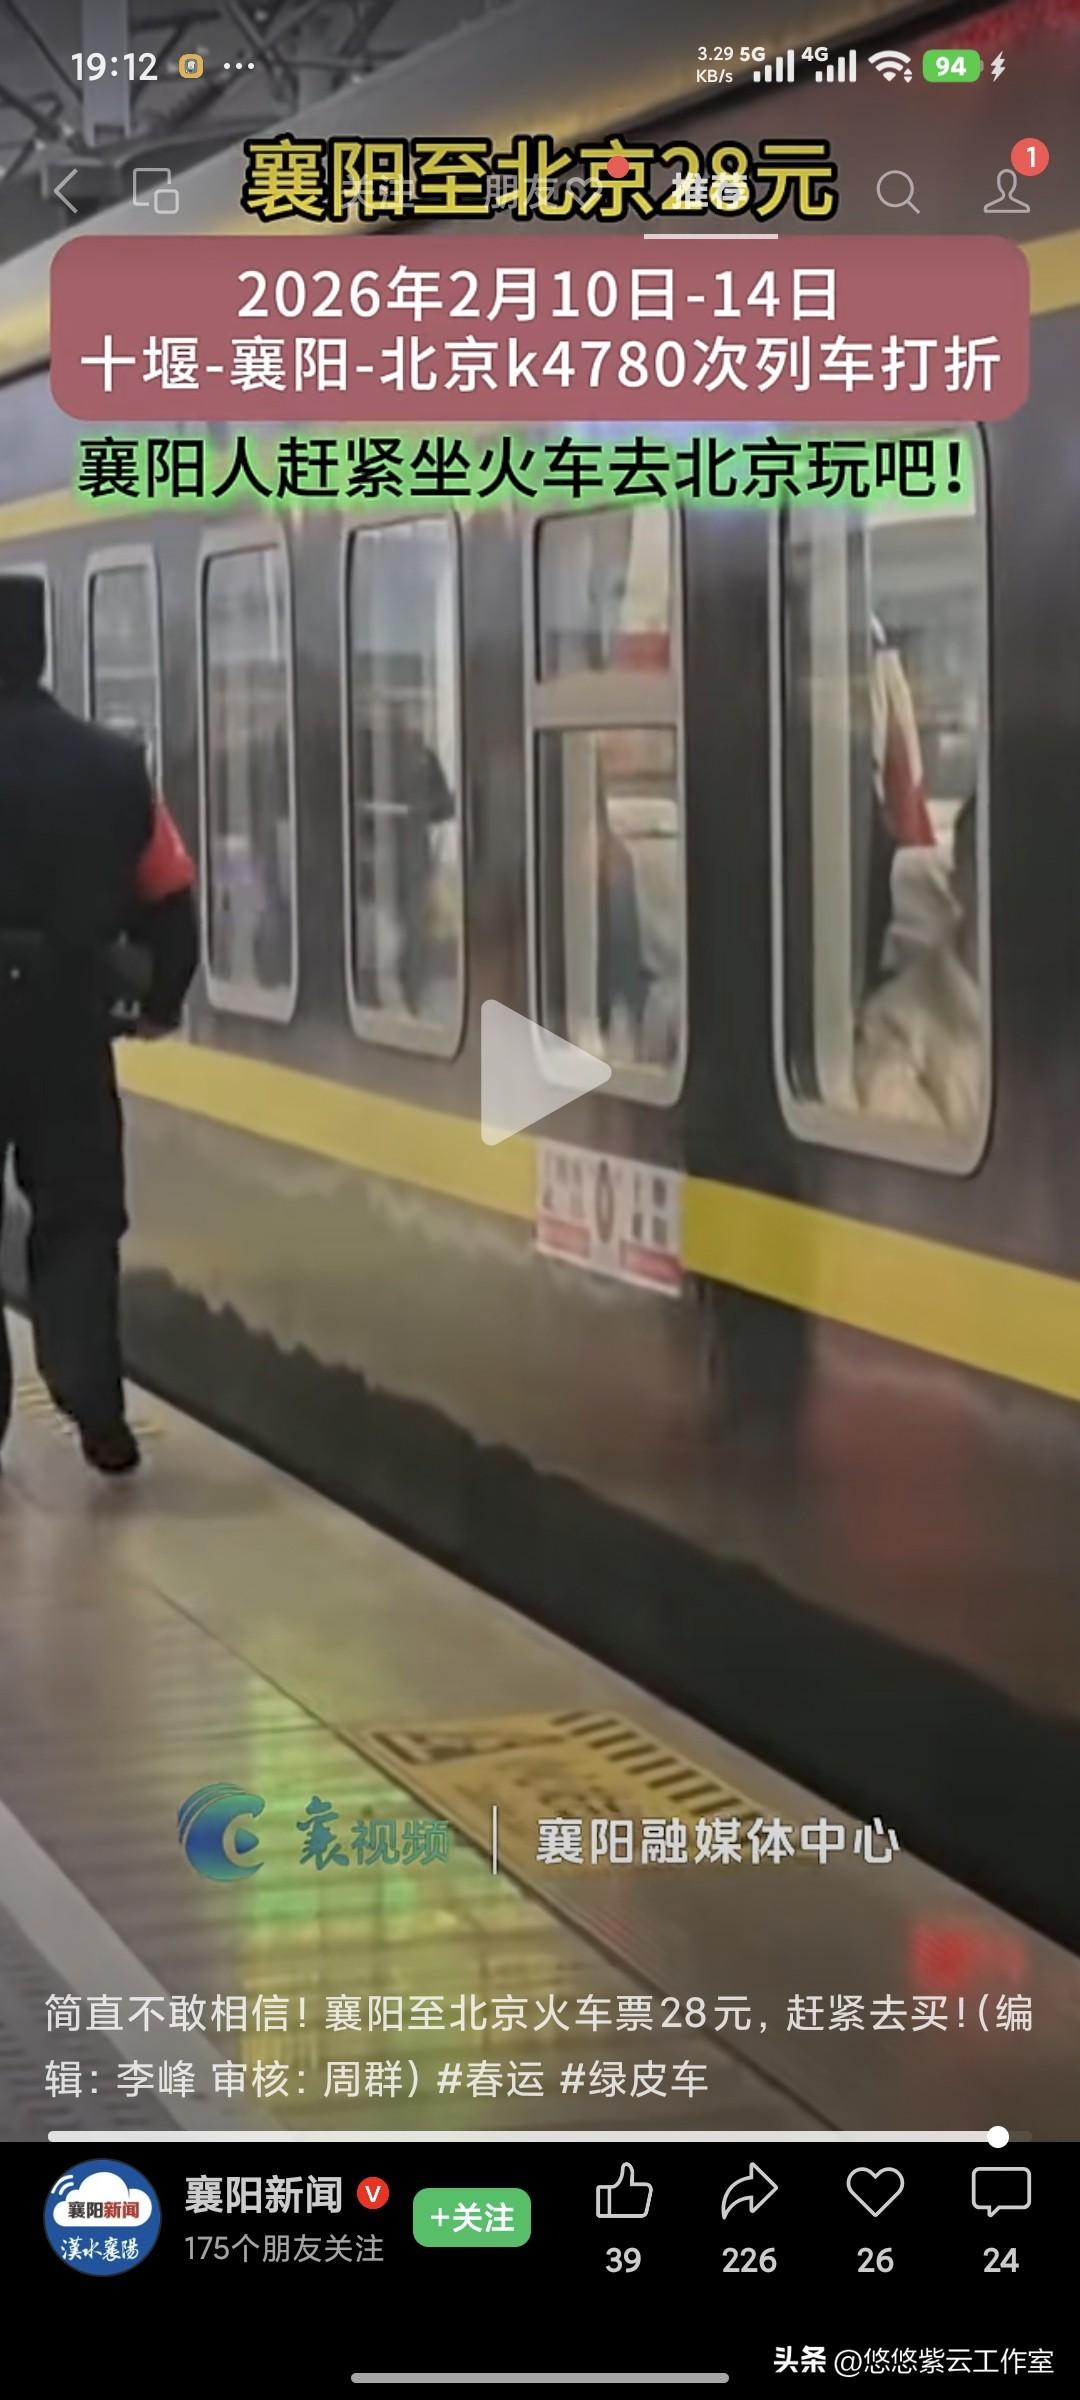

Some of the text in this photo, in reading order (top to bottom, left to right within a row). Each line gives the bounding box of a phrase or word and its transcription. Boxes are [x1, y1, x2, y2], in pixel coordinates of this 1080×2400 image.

[71, 53, 158, 81] 19:12
[697, 47, 734, 61] 3.29
[739, 47, 766, 61] 5G
[801, 47, 829, 61] 4G
[935, 56, 967, 77] 94
[696, 69, 733, 83] KB/s
[1026, 146, 1036, 168] 1
[437, 2060, 544, 2098] #春运
[560, 2060, 708, 2098] #绿皮车
[184, 2174, 342, 2214] 襄阳新闻
[68, 2201, 140, 2219] 襄阳新闻
[184, 2233, 384, 2263] 175个朋友关注
[605, 2247, 641, 2273] 39
[722, 2247, 777, 2273] 226
[857, 2247, 894, 2273] 26
[982, 2247, 1019, 2273] 24
